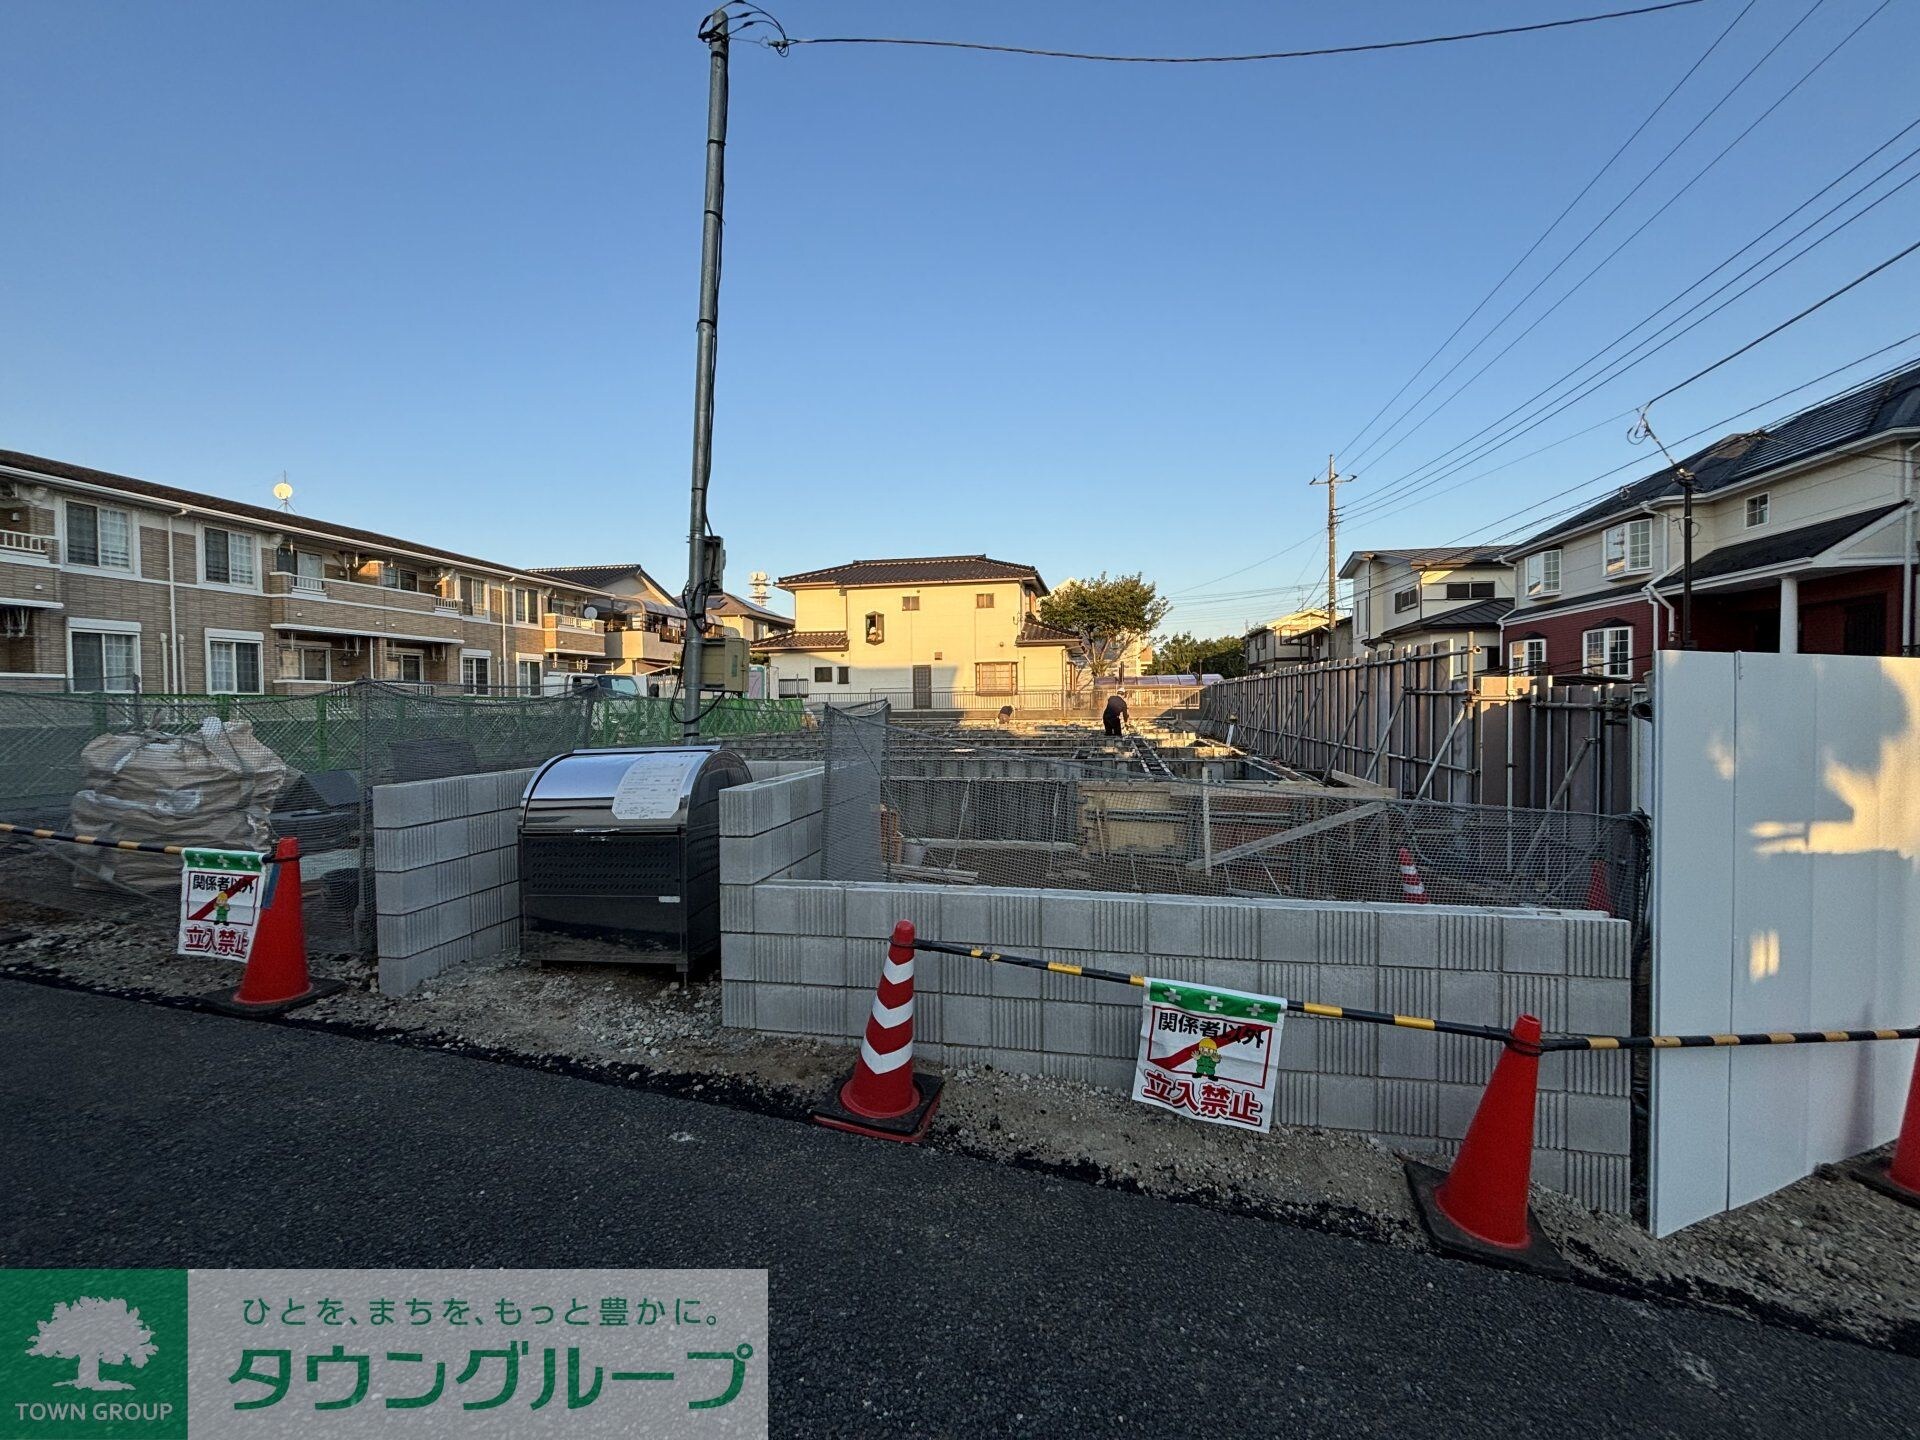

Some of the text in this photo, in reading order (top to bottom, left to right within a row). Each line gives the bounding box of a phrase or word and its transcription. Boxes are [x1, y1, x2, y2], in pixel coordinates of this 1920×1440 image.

[192, 874, 254, 894] 関係者以外
[184, 925, 250, 958] 立入禁止
[1158, 1012, 1264, 1049] 関係者以外
[1142, 1069, 1262, 1125] 立入禁止
